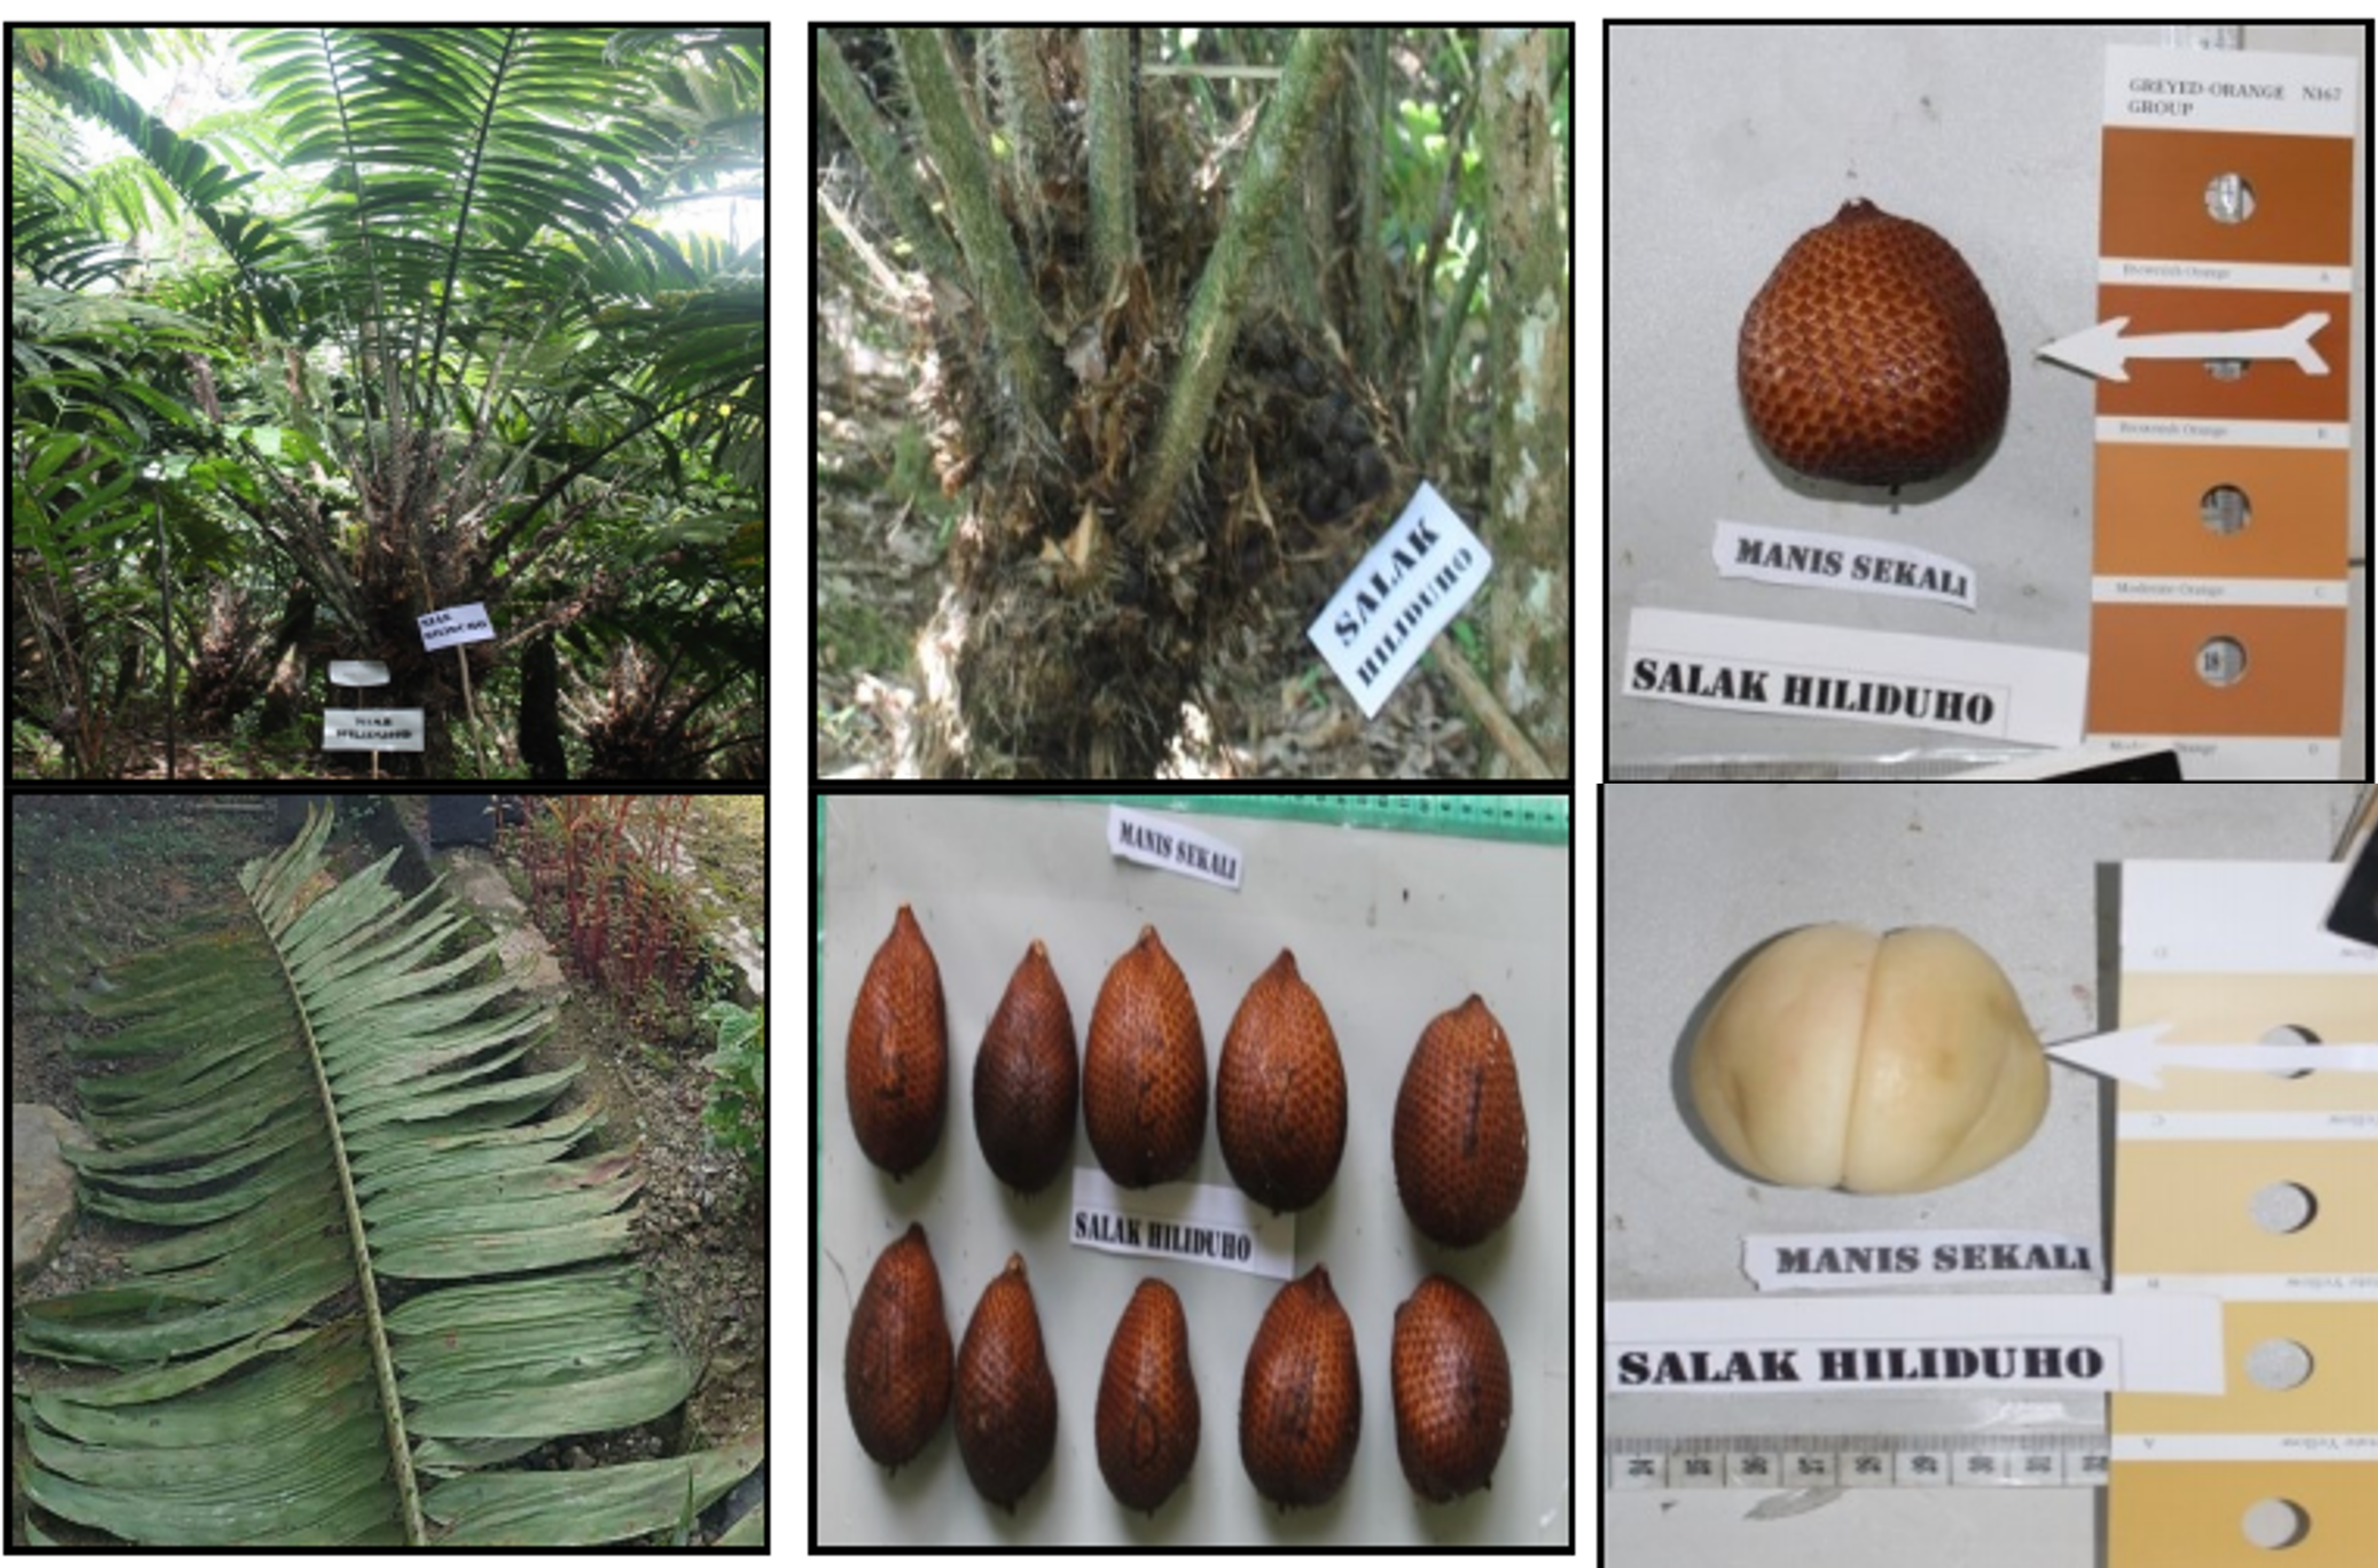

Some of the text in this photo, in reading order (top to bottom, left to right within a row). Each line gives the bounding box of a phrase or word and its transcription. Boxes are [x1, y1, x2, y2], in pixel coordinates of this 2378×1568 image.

[2127, 99, 2194, 116] GROUP
[2183, 424, 2228, 438] Orange
[1334, 517, 1441, 648] SALAK
[1735, 537, 1969, 599] MANIS SEKALI
[2179, 583, 2225, 597] Orange
[1356, 548, 1474, 687] HILIDUHO
[1631, 659, 1996, 726] SALAK HILIDUHO
[1119, 819, 1238, 880] MANIS SEKALI
[1075, 1211, 1252, 1261] SALAK HILIDUHO
[1775, 1244, 2091, 1275] MANIS SEKALI
[1616, 1346, 2105, 1385] SALAK HILIDUHO
[2280, 1437, 2340, 1450] Yellow
